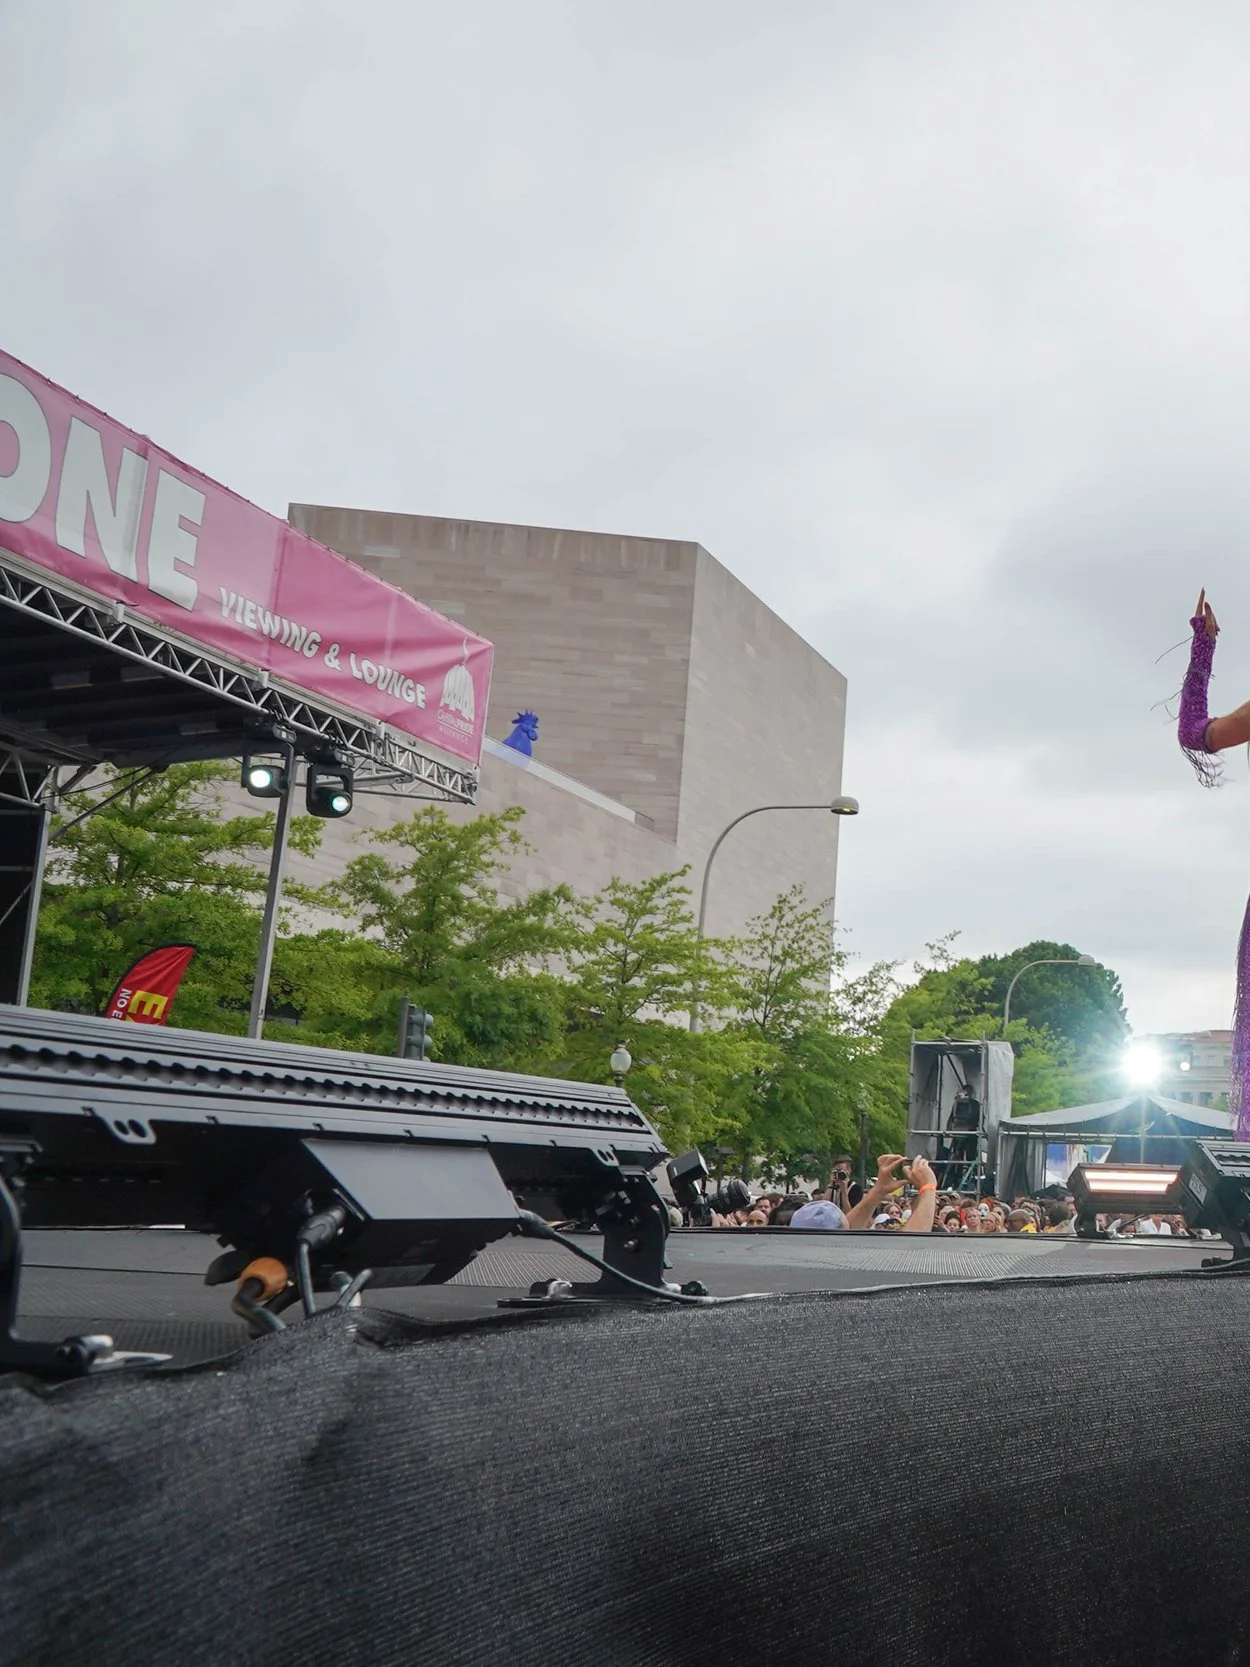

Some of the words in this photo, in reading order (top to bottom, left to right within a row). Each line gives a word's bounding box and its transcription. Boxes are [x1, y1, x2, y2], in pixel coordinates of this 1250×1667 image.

[219, 585, 322, 659] VIEWING
[323, 643, 343, 672] &
[349, 652, 426, 710] LOUNGE
[116, 988, 132, 1008] NO
